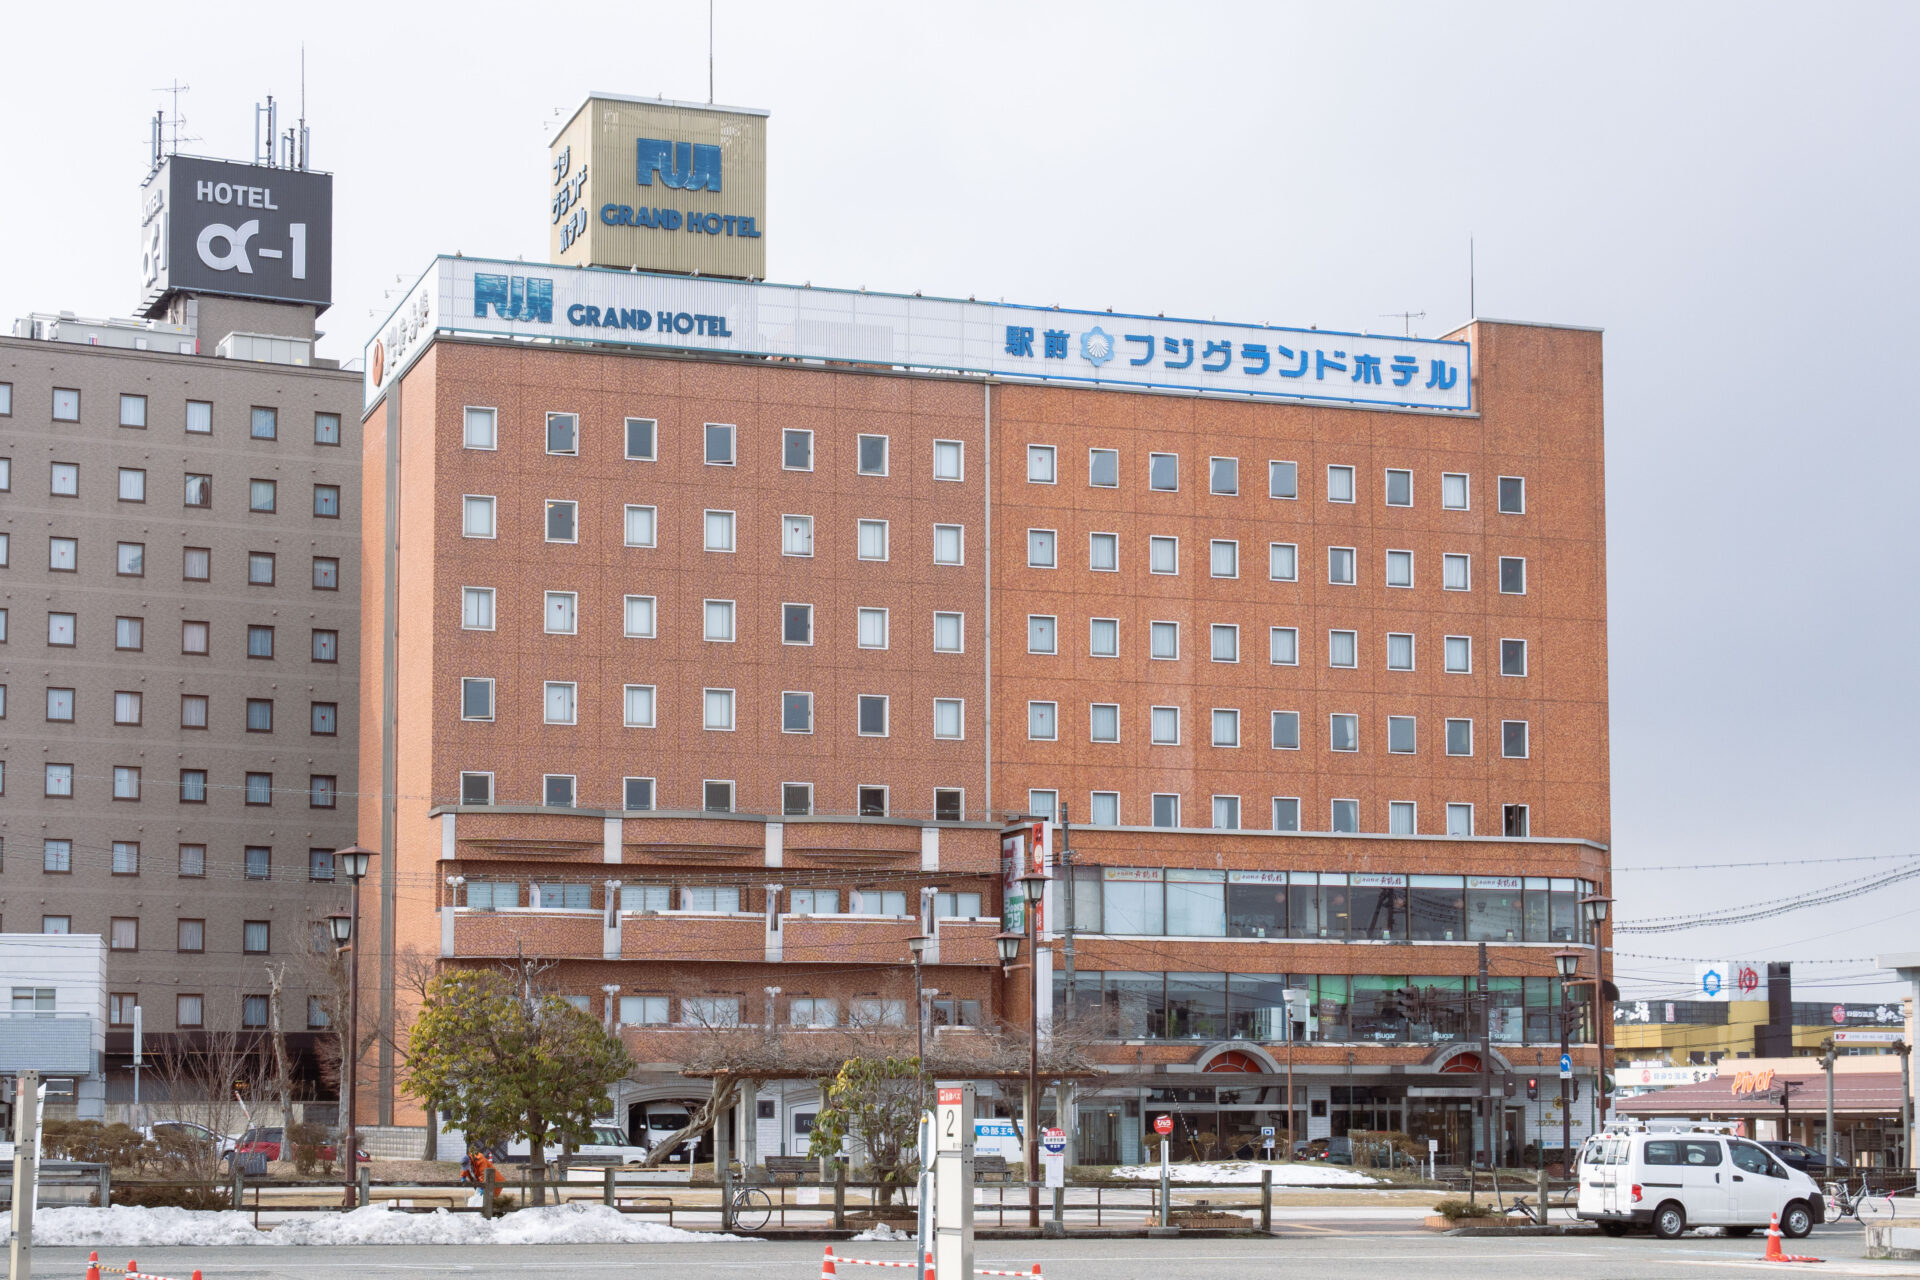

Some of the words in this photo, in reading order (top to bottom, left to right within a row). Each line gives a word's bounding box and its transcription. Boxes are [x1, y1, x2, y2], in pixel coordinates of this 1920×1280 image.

[197, 180, 278, 210] HOTEL
[601, 203, 682, 230] GRAND
[688, 211, 761, 238] HOTEL
[567, 303, 652, 331] GRAND
[657, 311, 732, 338] HOTEL
[1004, 325, 1070, 359] 駅前
[1124, 334, 1458, 390] フジグランドホテル
[1738, 967, 1758, 994] ゆ
[946, 1109, 954, 1137] 2
